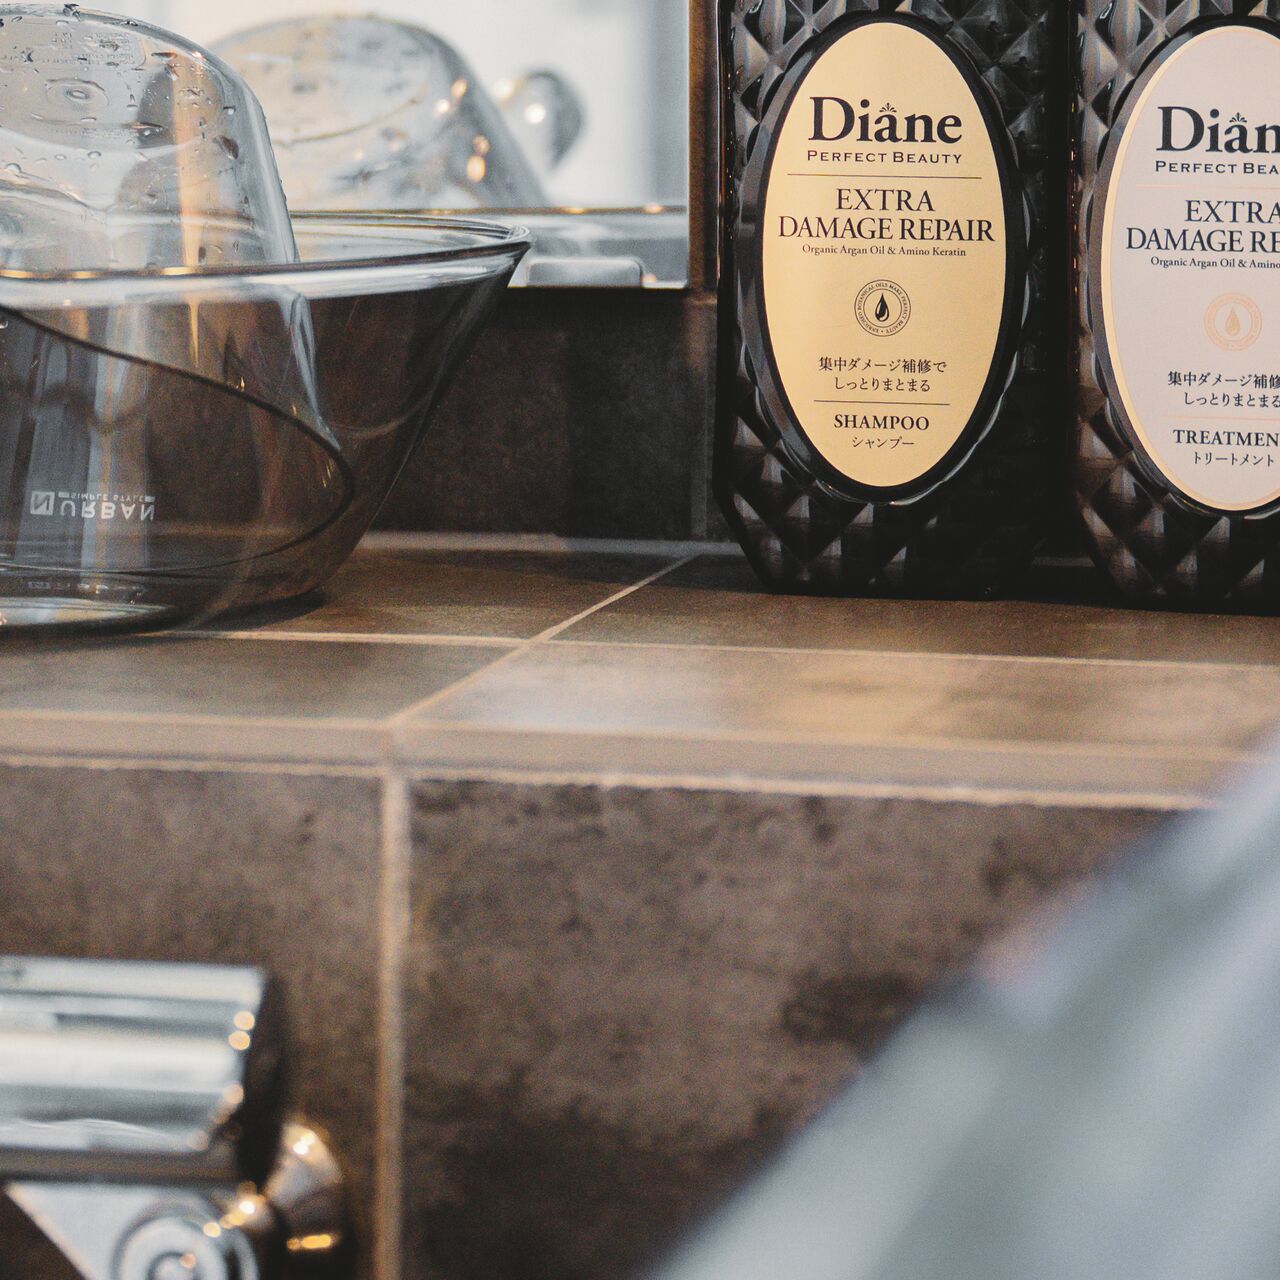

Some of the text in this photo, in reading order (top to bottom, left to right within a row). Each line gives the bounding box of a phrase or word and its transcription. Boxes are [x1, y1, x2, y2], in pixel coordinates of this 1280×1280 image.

[835, 187, 936, 212] EXTRA
[778, 215, 996, 243] DAMAGE REPAIR
[1125, 227, 1245, 253] DAMAGE
[801, 243, 967, 257] Organic Argan Oil & Amino Keratin
[1150, 256, 1188, 269] Organic
[1189, 257, 1218, 270] Argan
[1220, 257, 1235, 268] Oil
[1237, 258, 1248, 268] &
[818, 356, 948, 374] 集中ダメージ補修で
[834, 376, 931, 393] しっとりまとまる
[833, 413, 930, 431] SHAMPOO
[851, 435, 915, 450] シャンプー
[1193, 451, 1275, 468] トリートメント
